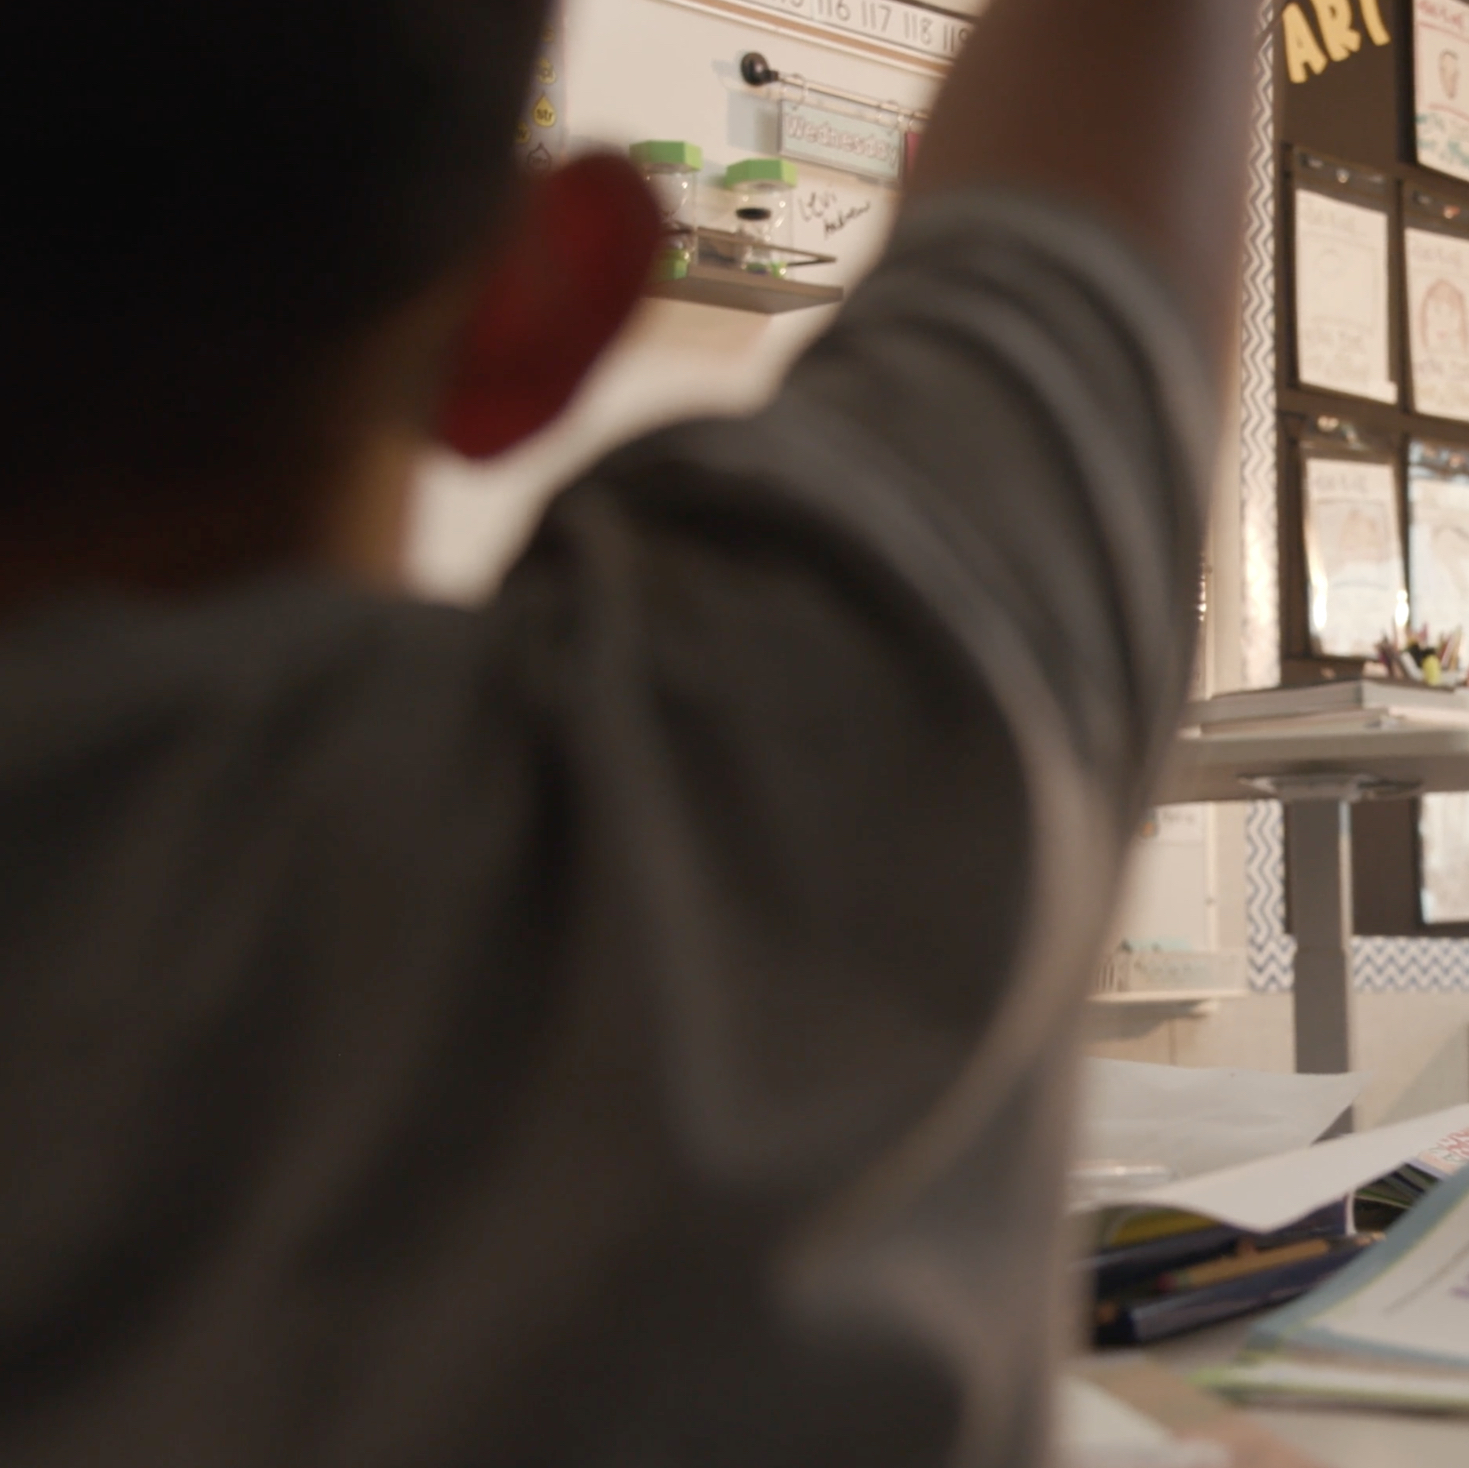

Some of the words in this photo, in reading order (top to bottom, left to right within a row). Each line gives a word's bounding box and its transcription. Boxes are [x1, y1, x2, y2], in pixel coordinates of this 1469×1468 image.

[816, 0, 851, 22] 116
[860, 2, 893, 33] 117
[902, 10, 935, 47] 118
[1282, 0, 1391, 84] ART
[783, 113, 898, 169] Wednesday
